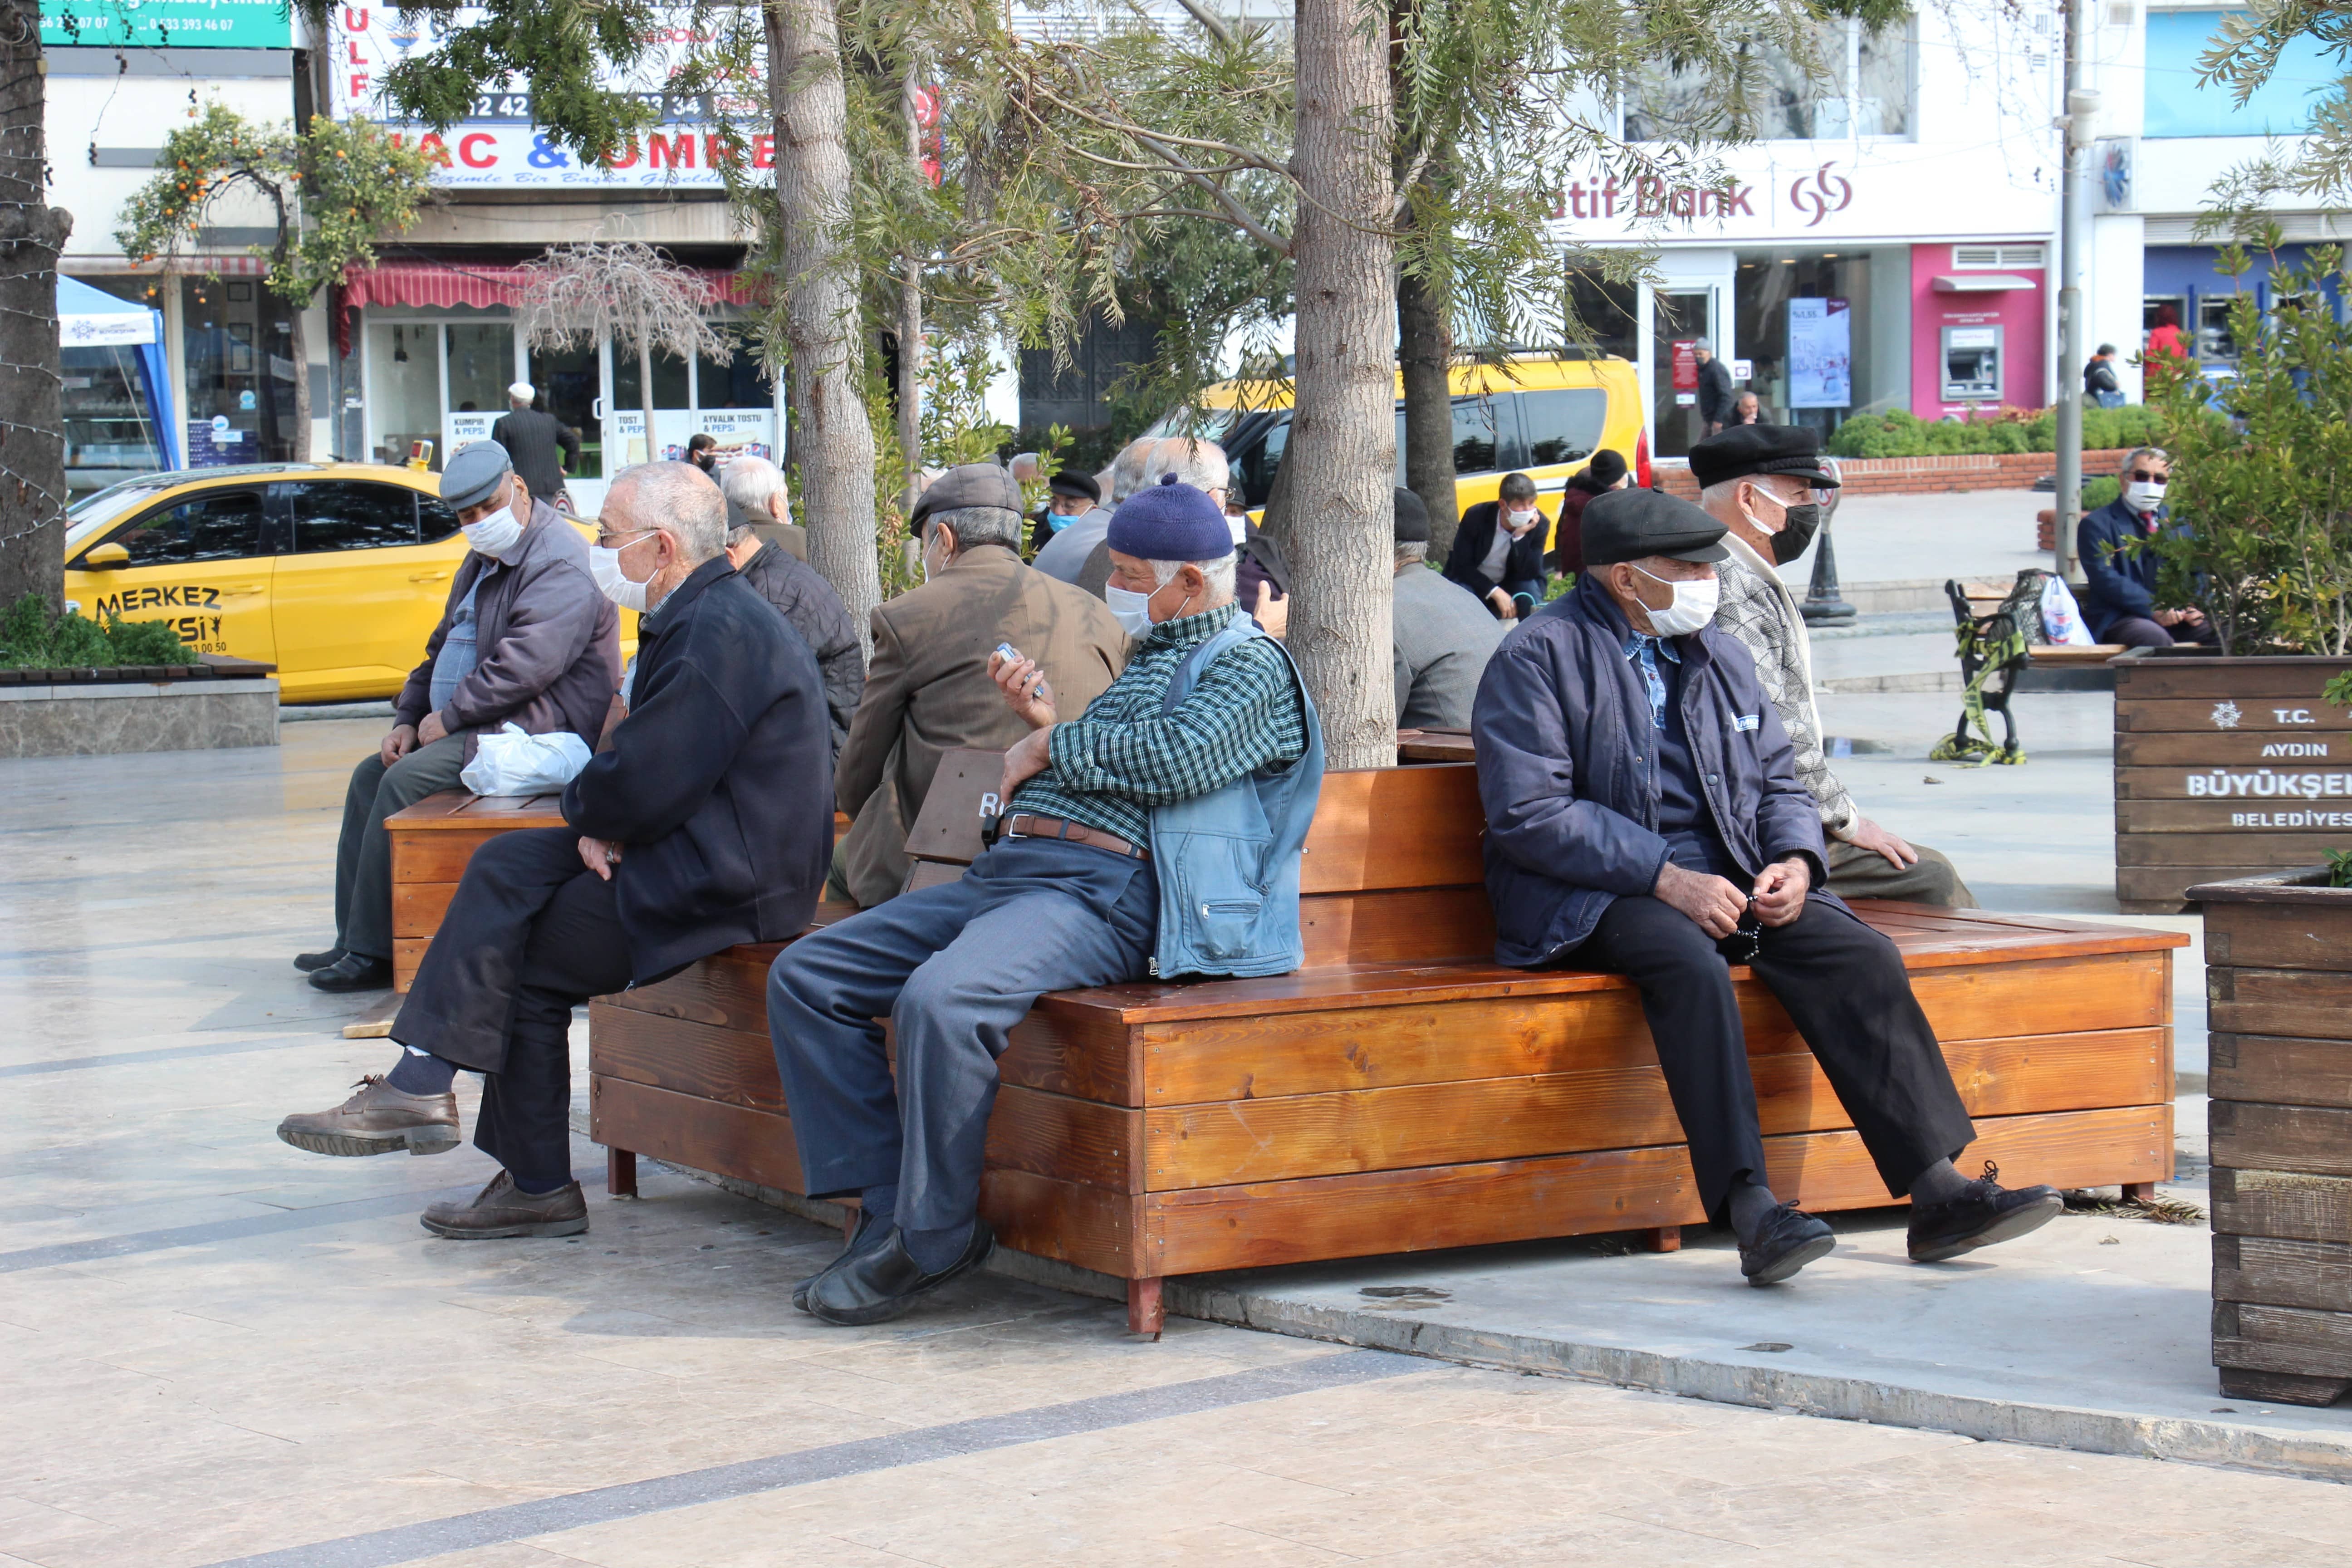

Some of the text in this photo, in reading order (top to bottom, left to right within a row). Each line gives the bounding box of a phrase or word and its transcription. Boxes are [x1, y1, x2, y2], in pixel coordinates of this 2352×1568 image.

[79, 17, 92, 28] 07
[95, 17, 109, 28] 07
[149, 18, 157, 29] 0
[182, 18, 201, 30] 393
[204, 19, 218, 30] 46
[220, 19, 234, 31] 07
[499, 96, 528, 116] 42
[671, 96, 701, 116] 34
[527, 134, 570, 169] &
[514, 172, 550, 182] Bir
[1636, 174, 1755, 218] Bank
[96, 586, 222, 621] MERKEZ
[201, 643, 213, 653] 00
[216, 642, 226, 652] 50
[2273, 710, 2315, 724] T.C.
[2261, 744, 2328, 757] AYDIN
[2232, 810, 2352, 827] BELEDİYES
